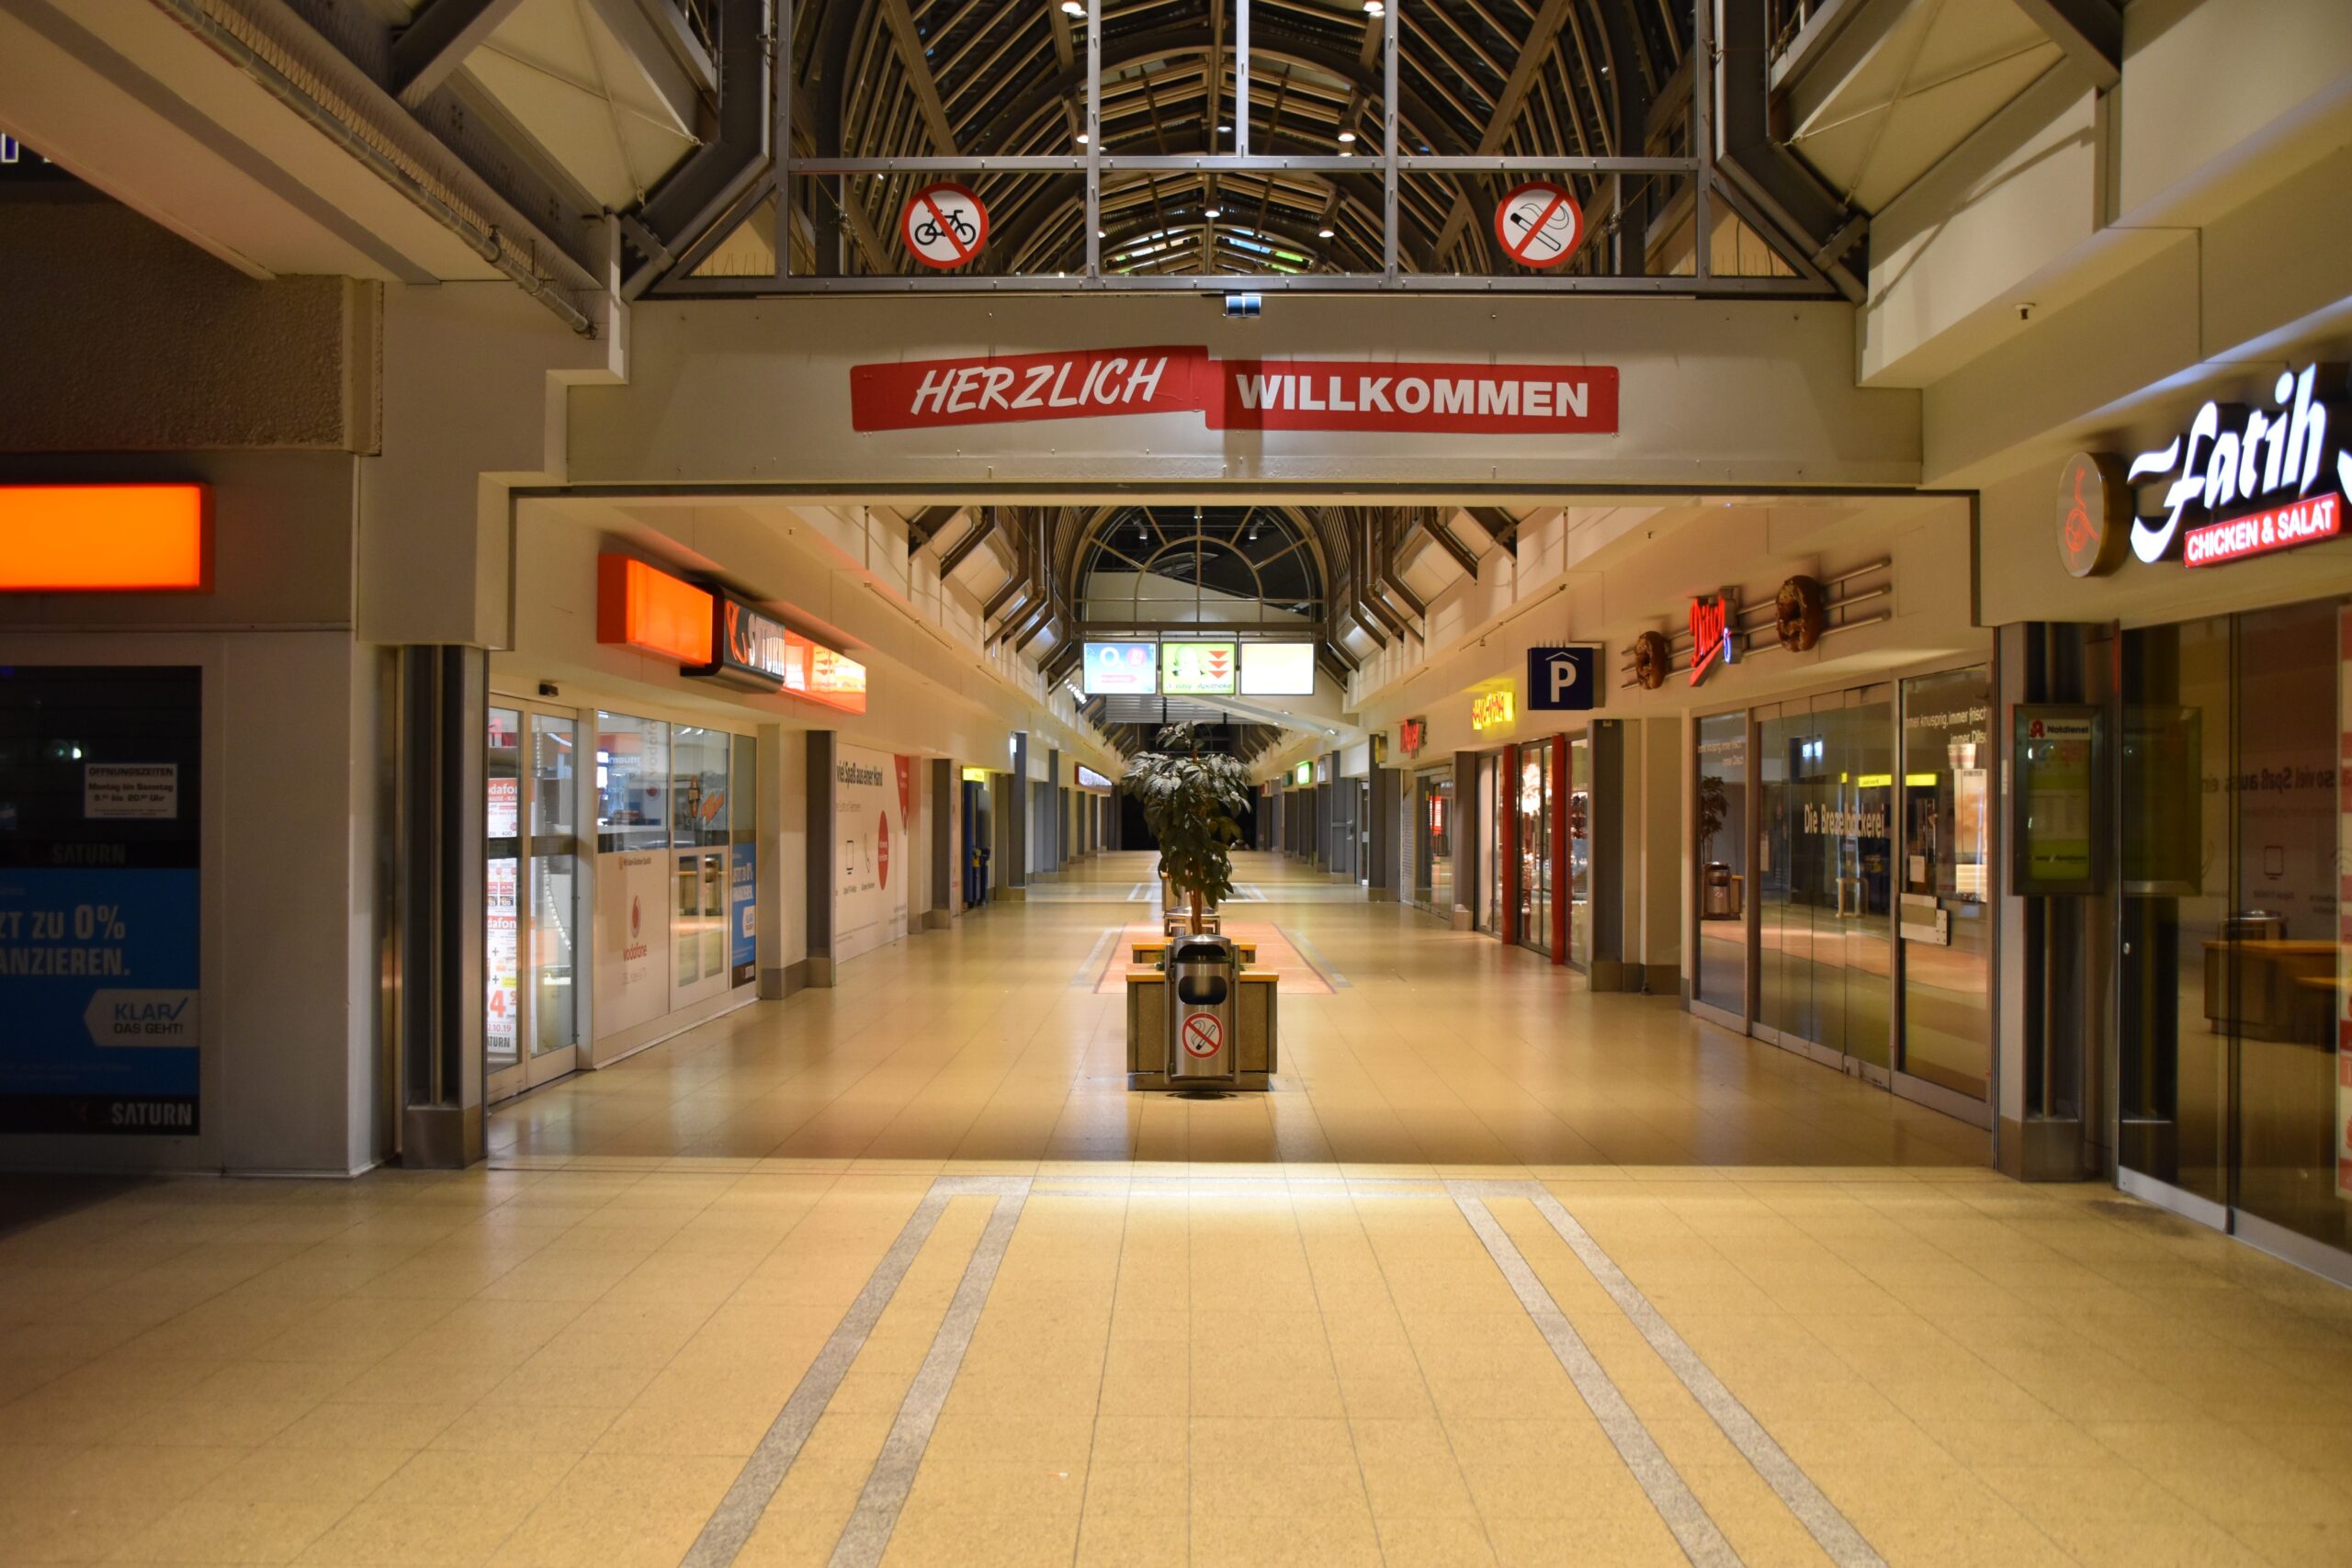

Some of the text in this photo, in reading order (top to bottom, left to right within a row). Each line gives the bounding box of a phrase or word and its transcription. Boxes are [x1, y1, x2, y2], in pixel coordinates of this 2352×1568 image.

[910, 356, 1589, 418] HERZLICH WILLKOMMEN
[2188, 500, 2335, 562] CHICKEN & SALAT
[1551, 661, 1577, 703] P
[2047, 725, 2088, 734] Notdienst
[1804, 801, 1884, 838] Die Brezelbäckerei
[51, 842, 127, 864] SATURN
[31, 911, 65, 940] ZU
[74, 903, 126, 941] 0%
[623, 942, 648, 962] vodafone
[114, 1002, 173, 1021] KLAR
[114, 1022, 184, 1035] DAS GEHT!
[111, 1102, 193, 1126] SATURN
